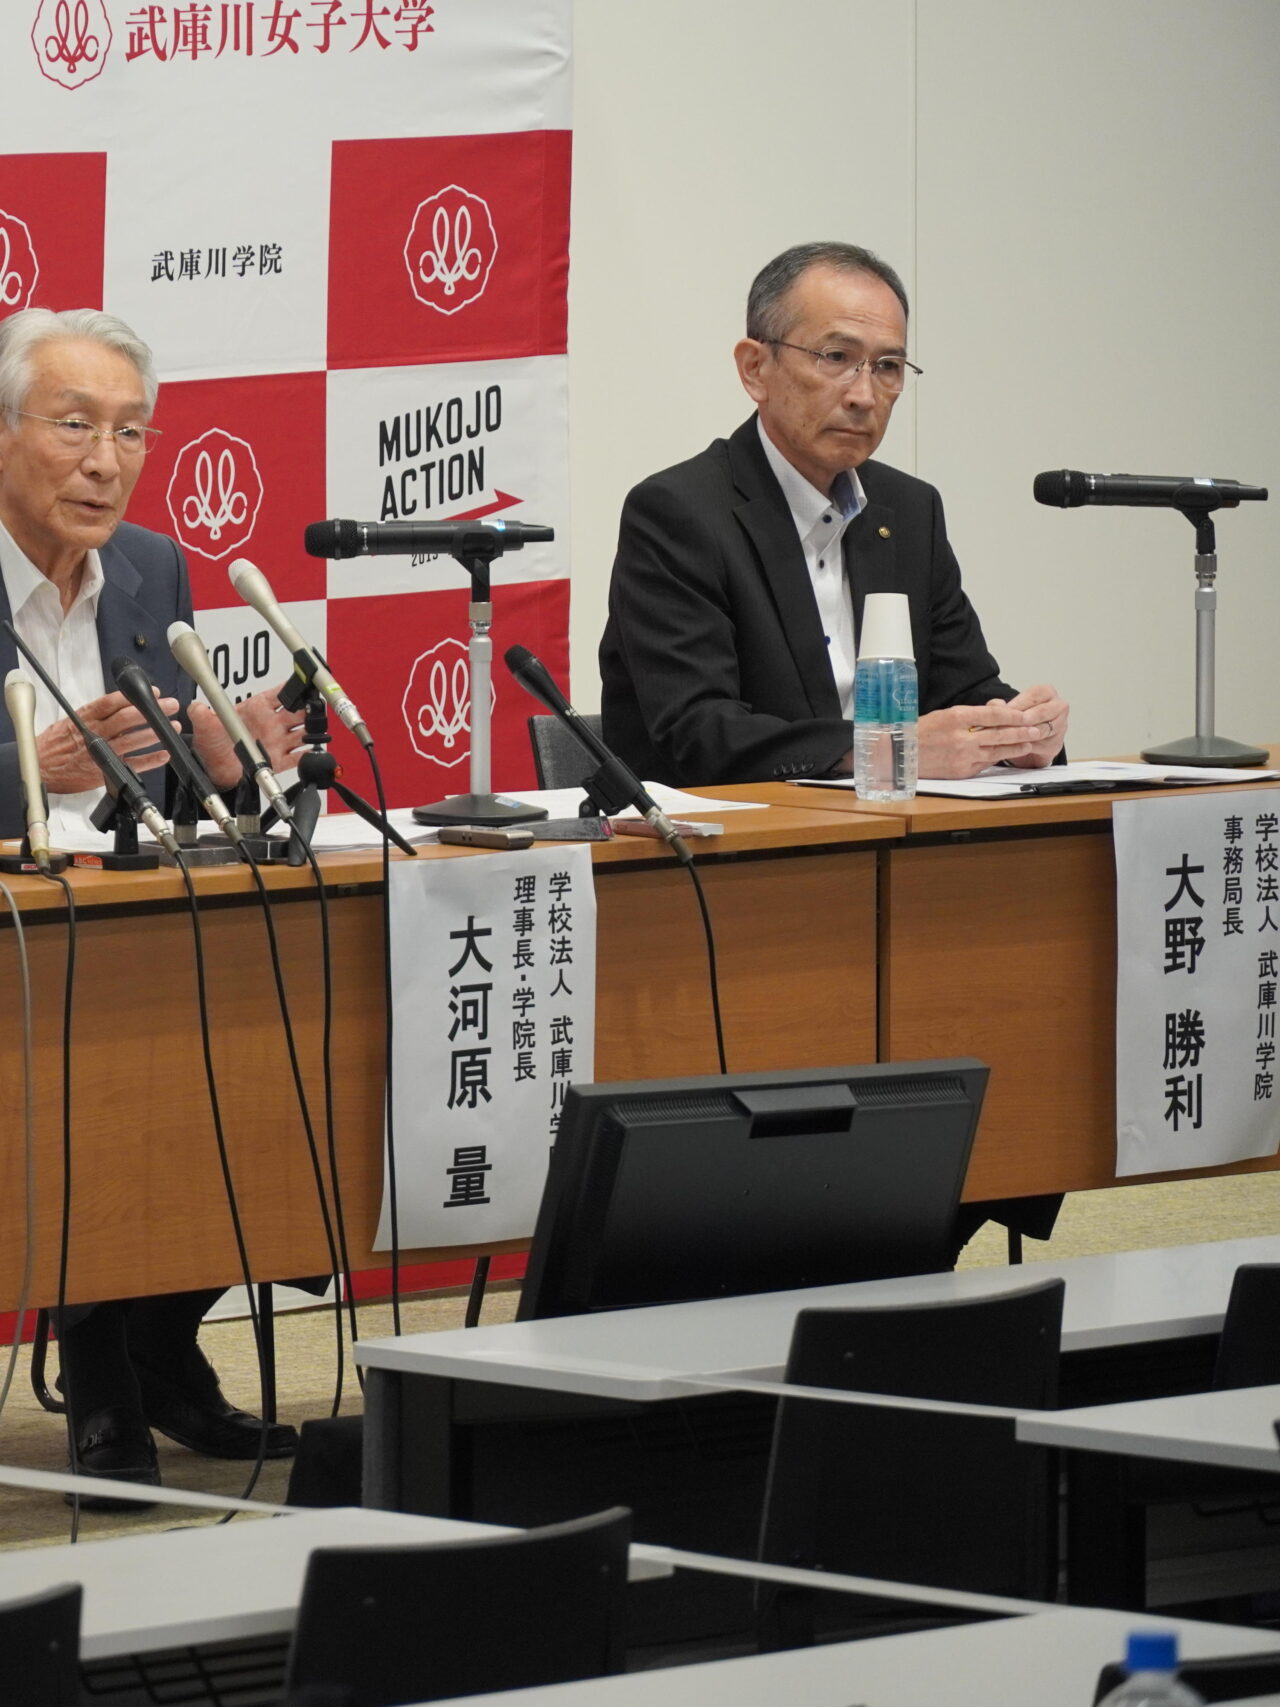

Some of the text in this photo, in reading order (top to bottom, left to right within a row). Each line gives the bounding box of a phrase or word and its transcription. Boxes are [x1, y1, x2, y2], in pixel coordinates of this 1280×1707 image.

[125, 0, 436, 62] 武庫川女子大学
[150, 243, 284, 282] 武庫川学院
[378, 384, 503, 468] MUKOJO
[379, 446, 485, 521] ACTION
[547, 871, 574, 998] 学校法人
[1222, 815, 1245, 937] 事務局長
[512, 875, 537, 1083] 理事長・学院長
[1162, 853, 1207, 1132] 大野 勝利
[1253, 812, 1280, 1101] 学校法人 武庫川学院
[442, 915, 494, 1209] 大河原 量
